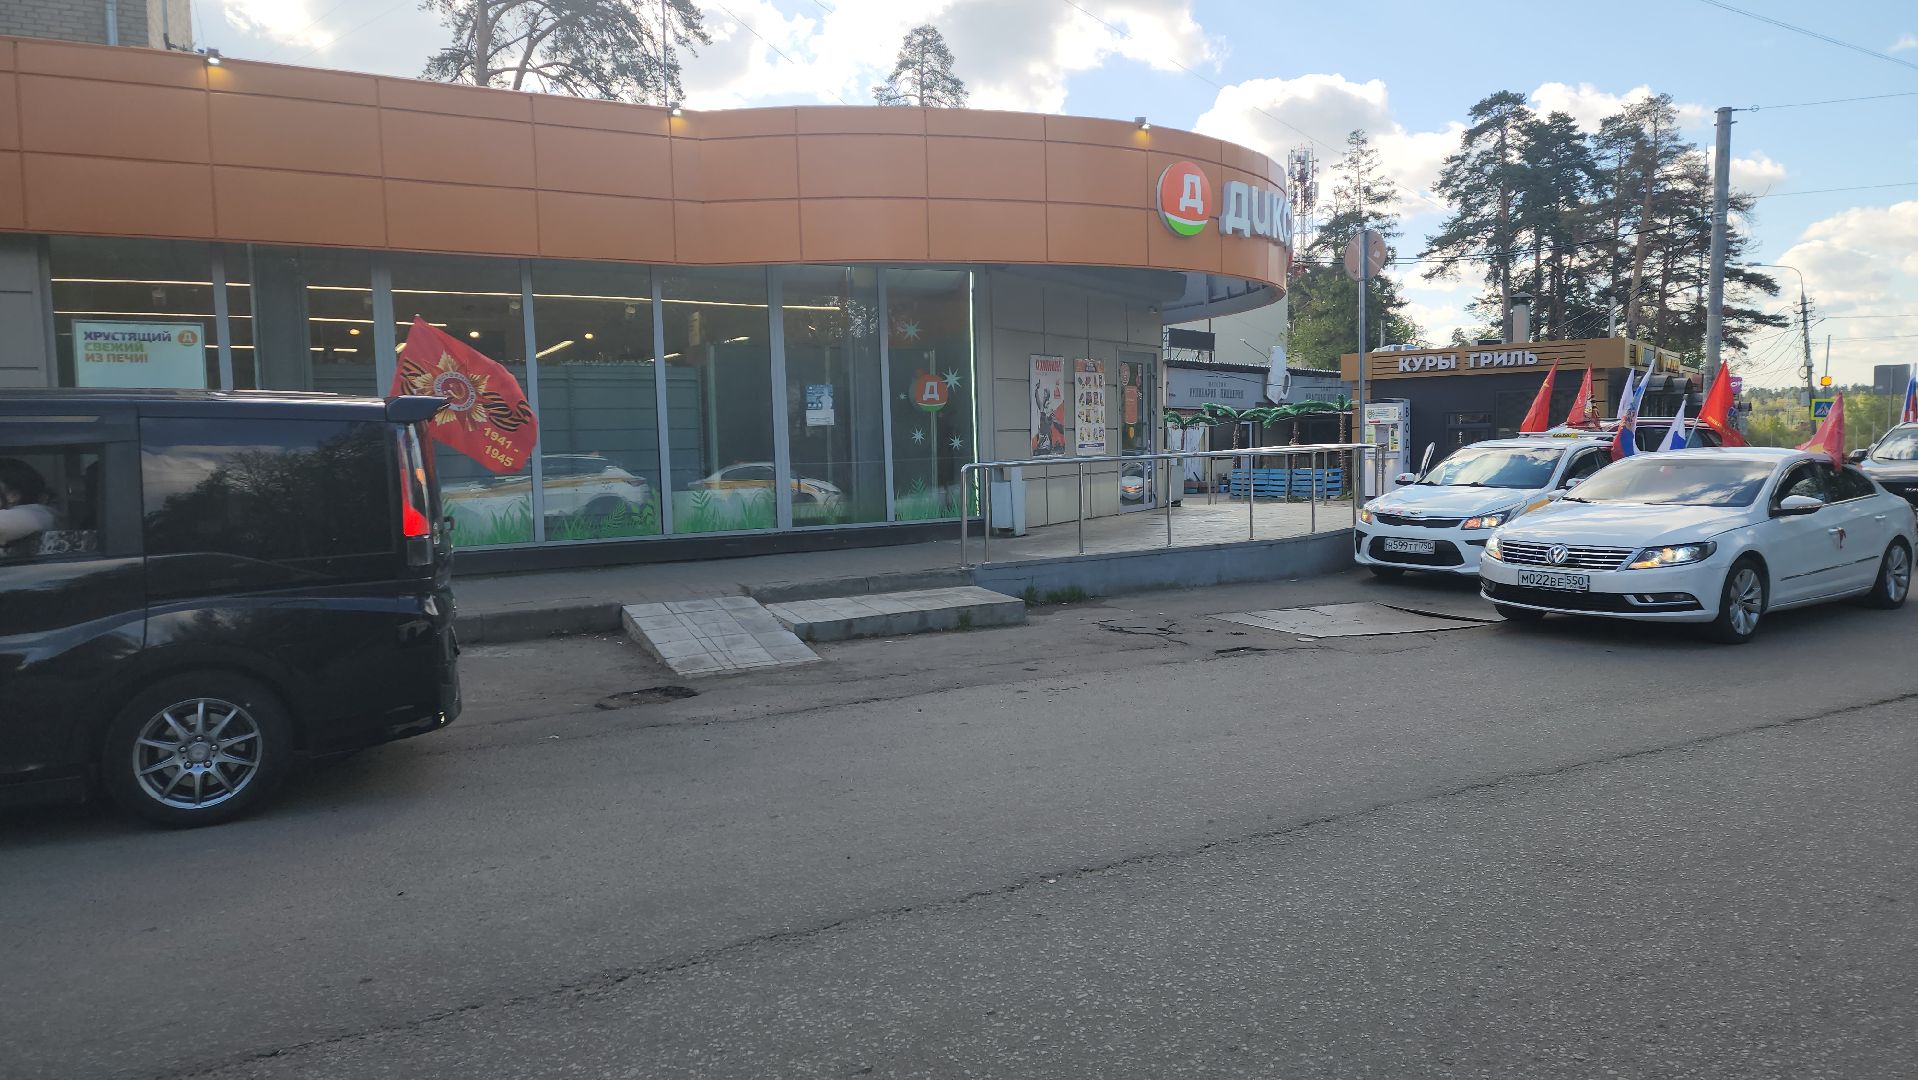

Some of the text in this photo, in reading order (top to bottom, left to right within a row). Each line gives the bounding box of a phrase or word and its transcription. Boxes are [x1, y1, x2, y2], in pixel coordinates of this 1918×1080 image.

[83, 330, 172, 343] ХРУСТЯЩИЙ
[84, 341, 144, 353] СВЕЖИЙ
[85, 352, 103, 363] ИЗ
[1398, 350, 1538, 372] КУРЫ ГРИЛЬ
[483, 427, 513, 449] 1941
[484, 445, 514, 467] 1945
